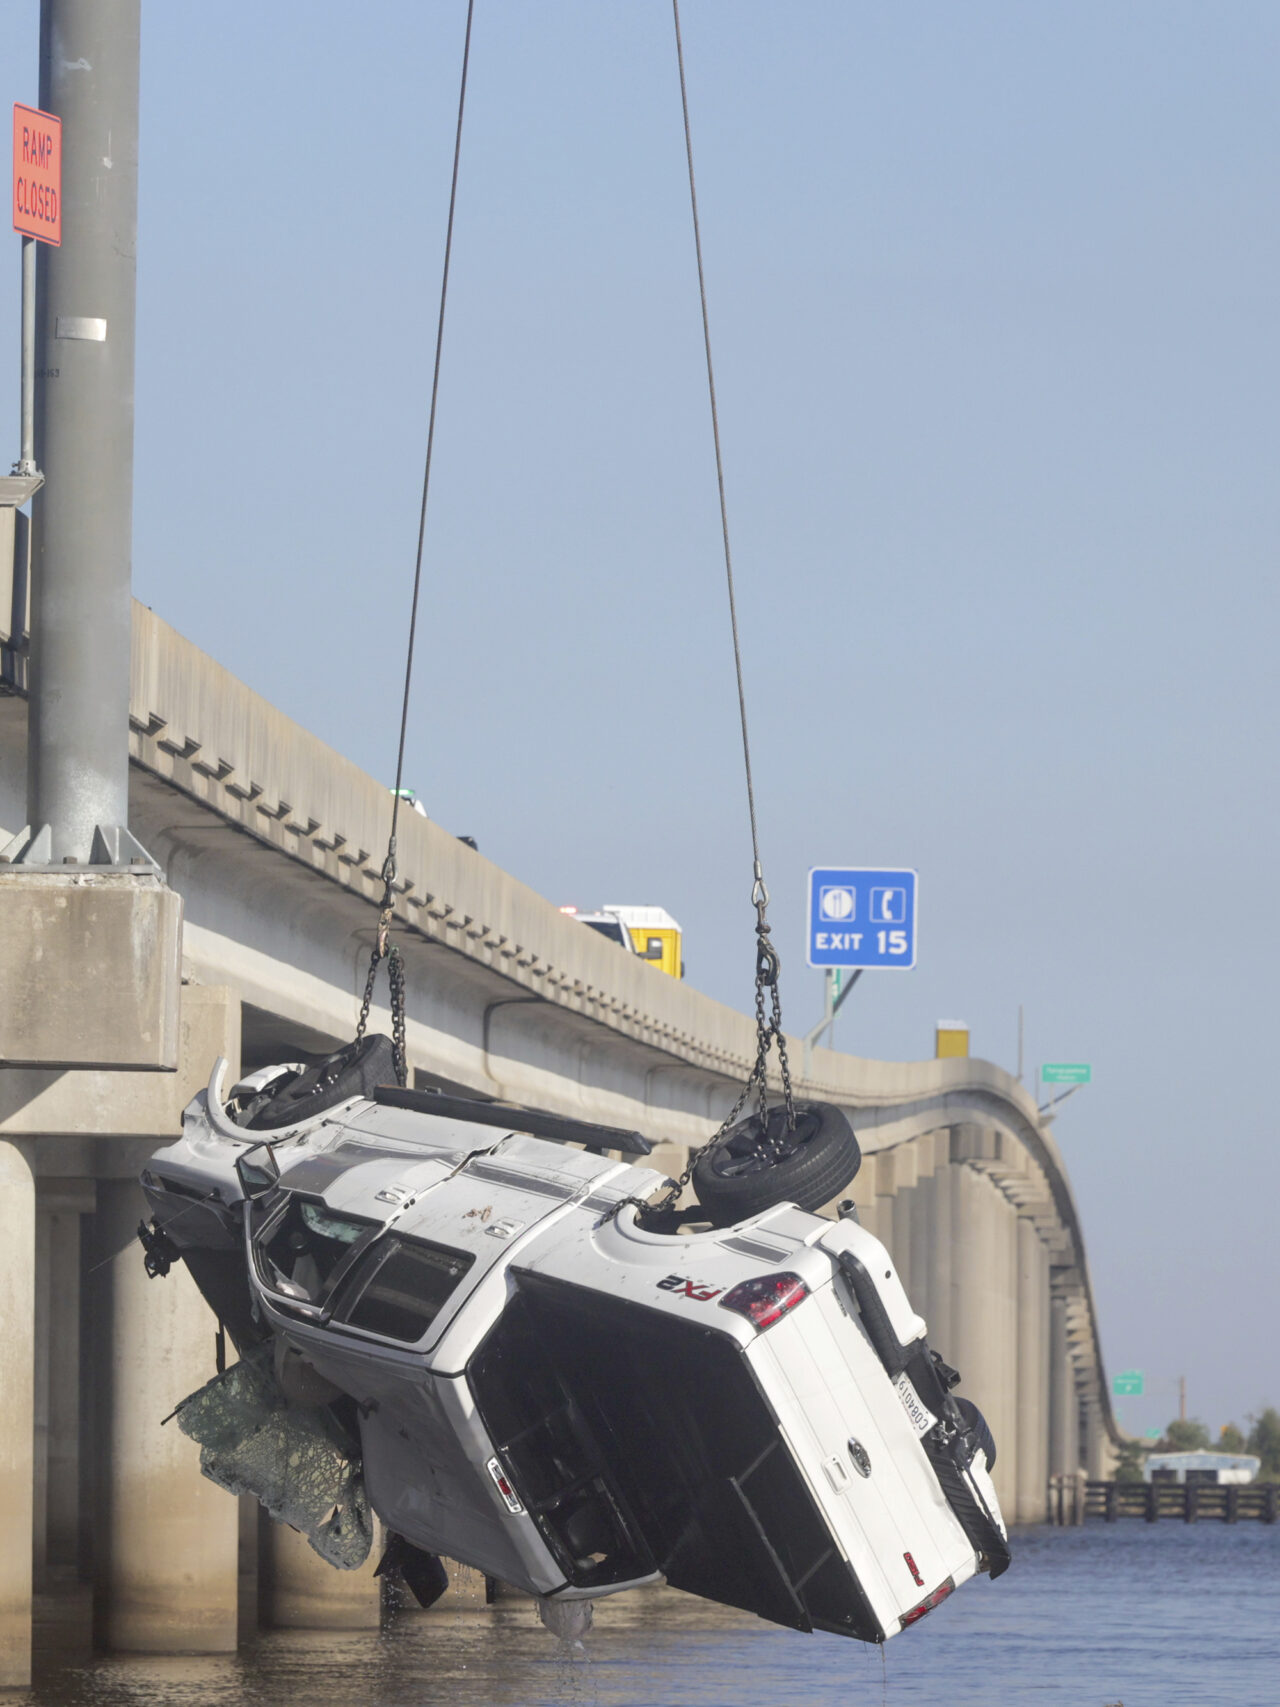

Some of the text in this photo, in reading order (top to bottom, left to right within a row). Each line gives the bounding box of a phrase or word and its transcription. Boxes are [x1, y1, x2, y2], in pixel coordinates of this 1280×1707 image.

[23, 126, 52, 170] RAMP
[17, 177, 57, 223] CLOSED
[816, 931, 907, 954] EXIT 15
[656, 1275, 722, 1301] FX2
